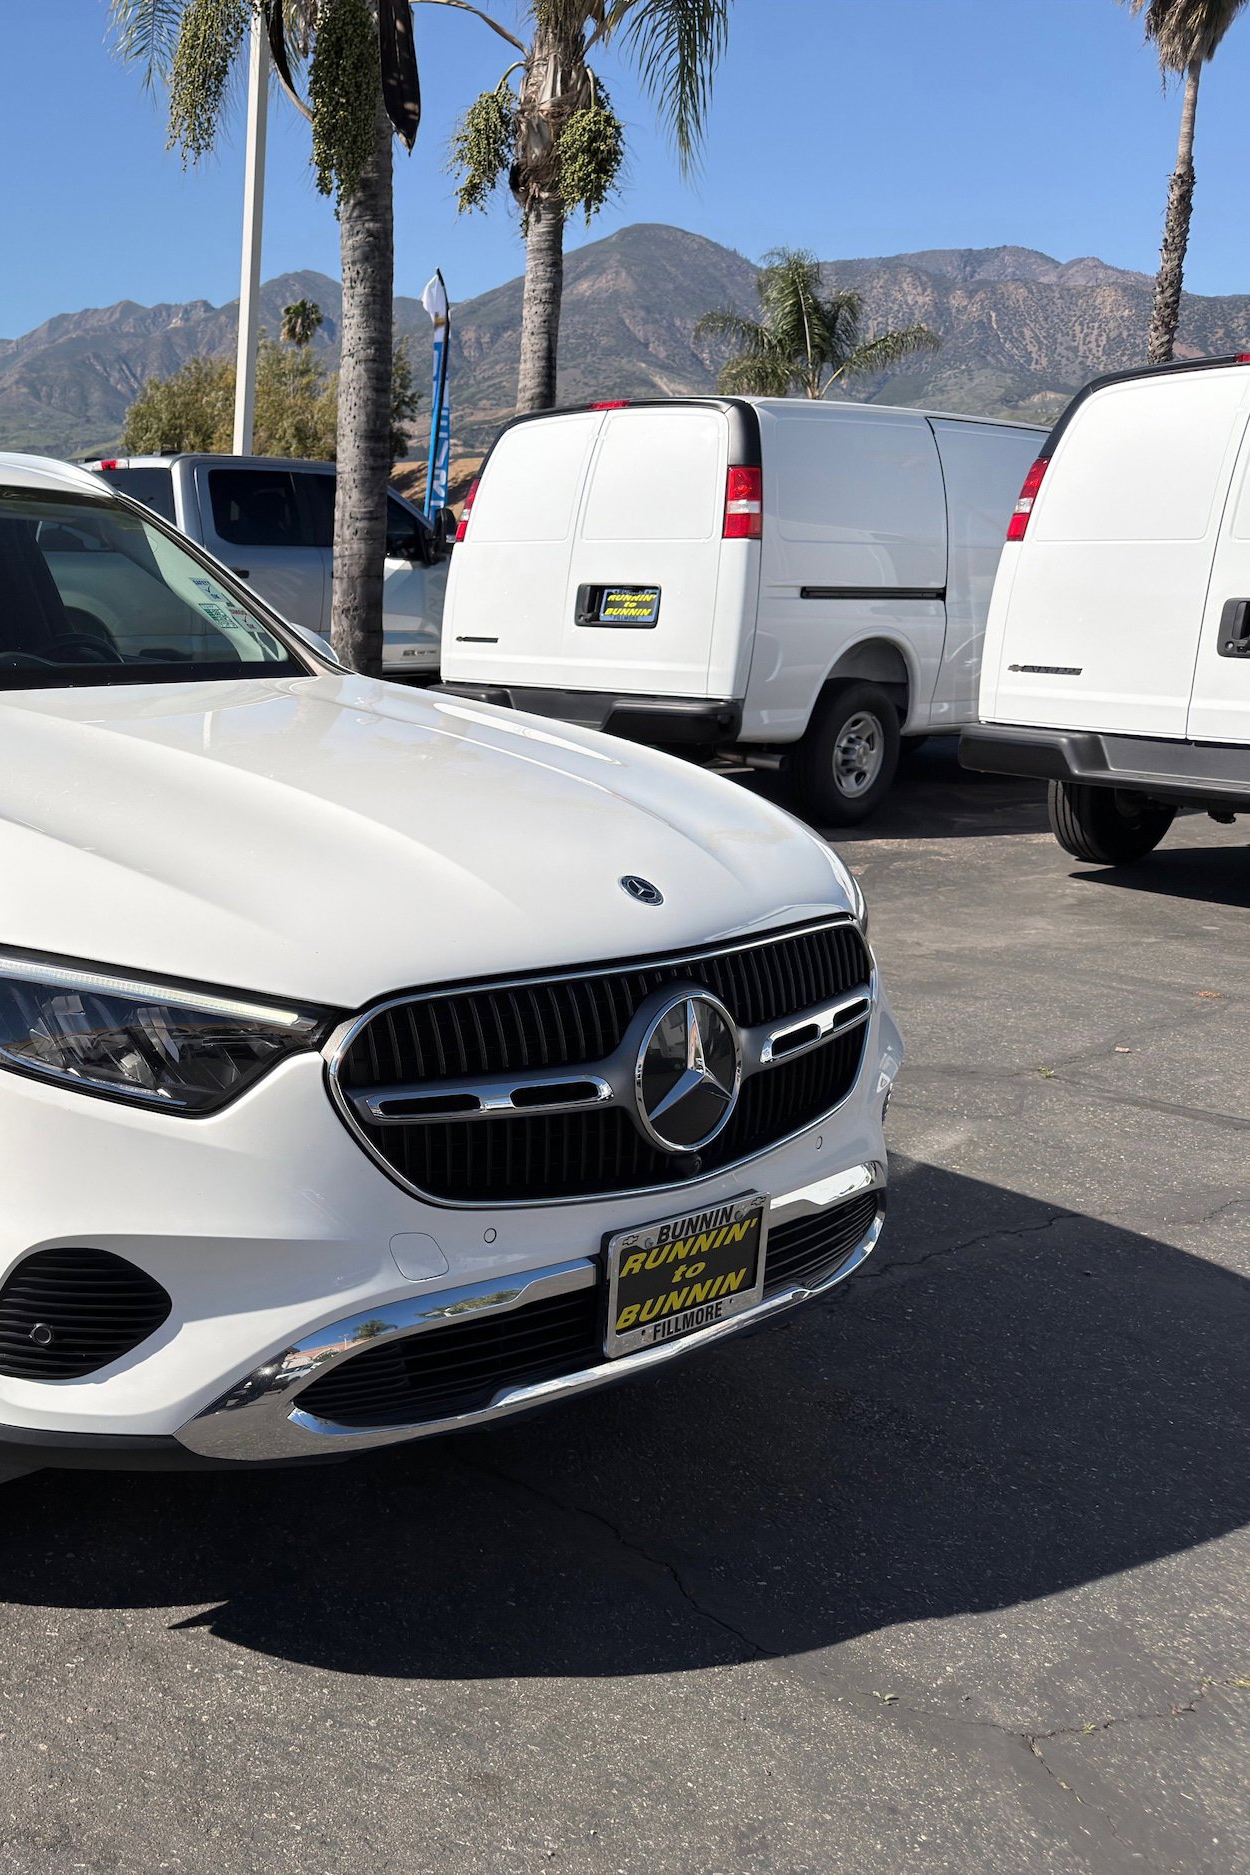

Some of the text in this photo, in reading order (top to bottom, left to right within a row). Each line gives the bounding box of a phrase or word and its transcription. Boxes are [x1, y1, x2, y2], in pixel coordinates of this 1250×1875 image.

[605, 607, 652, 616] BUNNIN
[608, 594, 657, 602] RUNNIN'
[657, 1205, 735, 1244] BUNNIN
[619, 1217, 758, 1279] RUNNIN'
[671, 1262, 707, 1284] to
[615, 1268, 747, 1331] BUNNIN
[652, 1301, 723, 1341] FILLMORE
